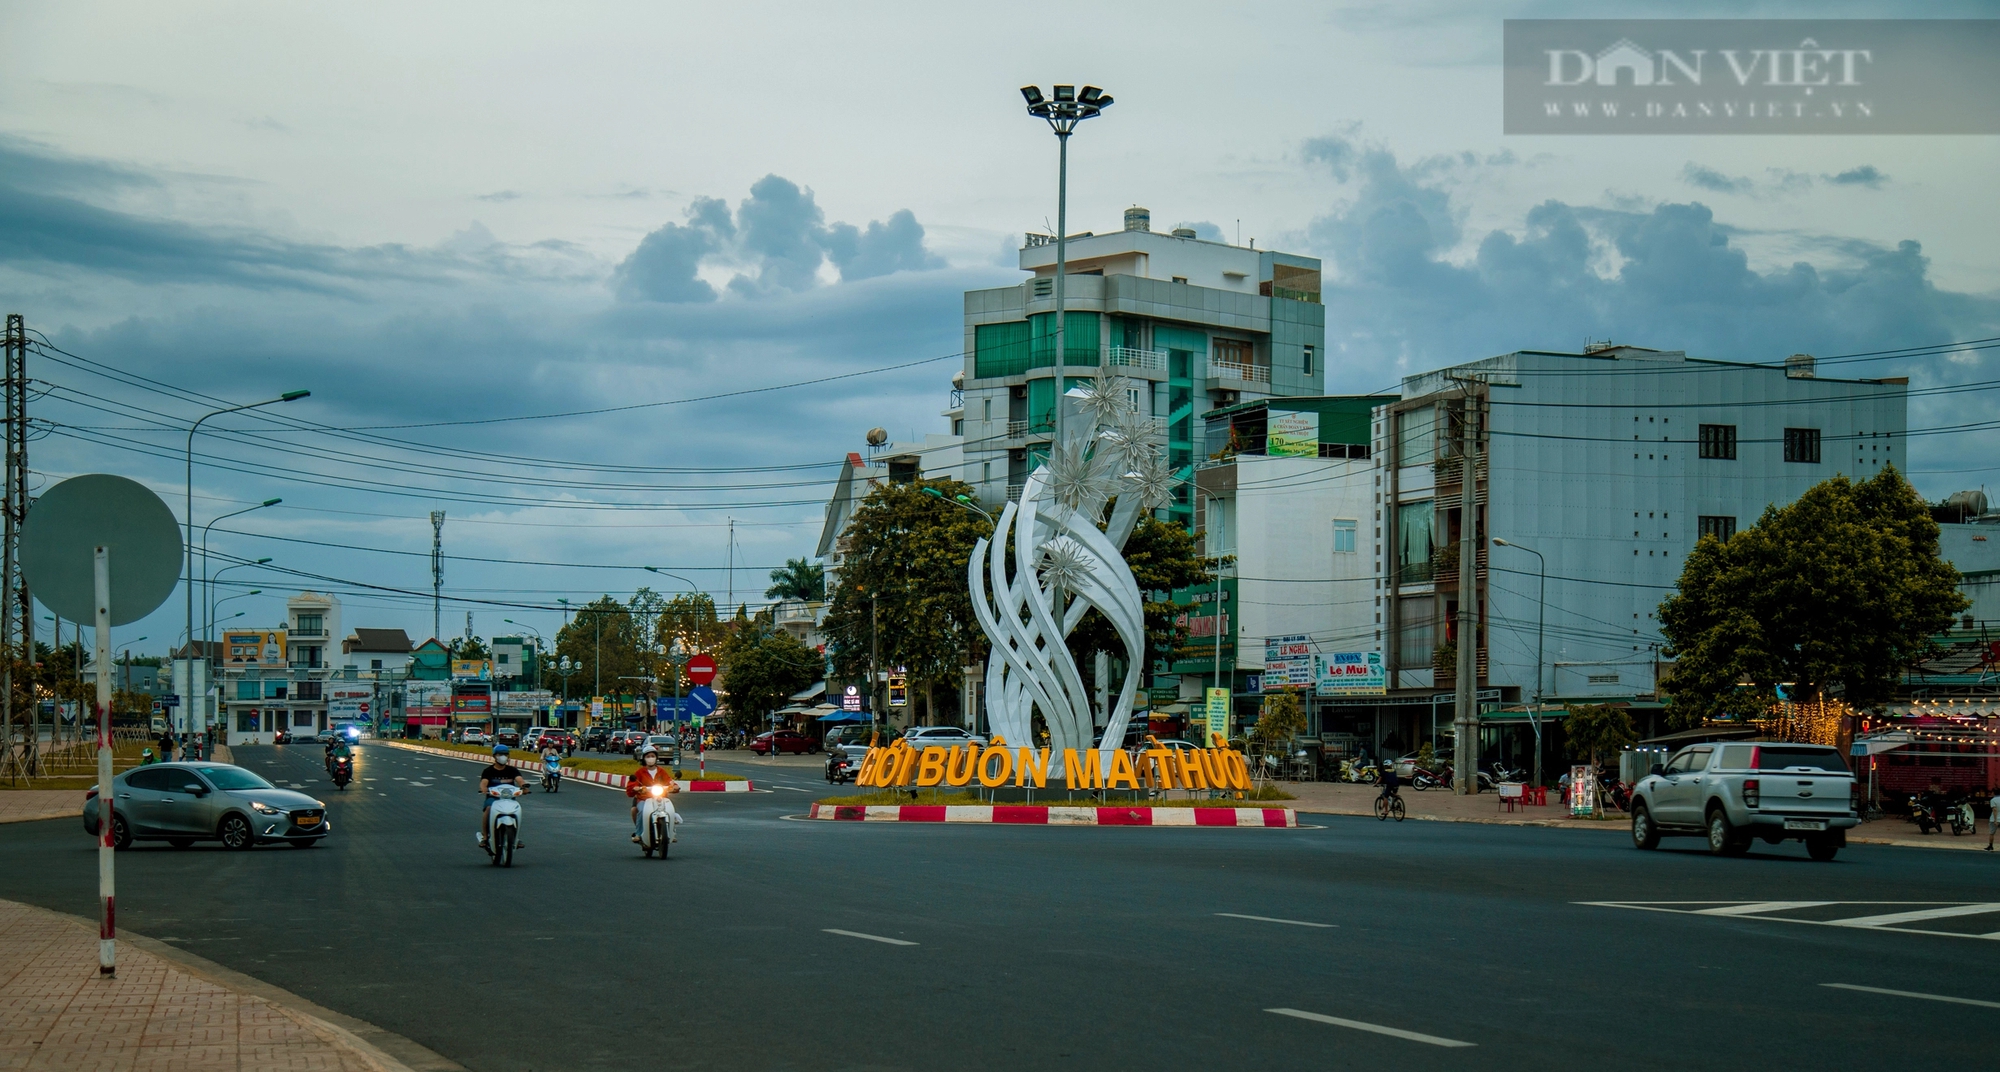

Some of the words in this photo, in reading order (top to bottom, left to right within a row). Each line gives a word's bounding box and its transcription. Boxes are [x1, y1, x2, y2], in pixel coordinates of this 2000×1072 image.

[1271, 437, 1284, 446] 170
[1280, 644, 1287, 655] LÊ
[1289, 643, 1309, 655] NGHĨA
[856, 738, 916, 788] GIỚI
[917, 735, 1050, 789] BUÔN
[1063, 748, 1139, 791] MA
